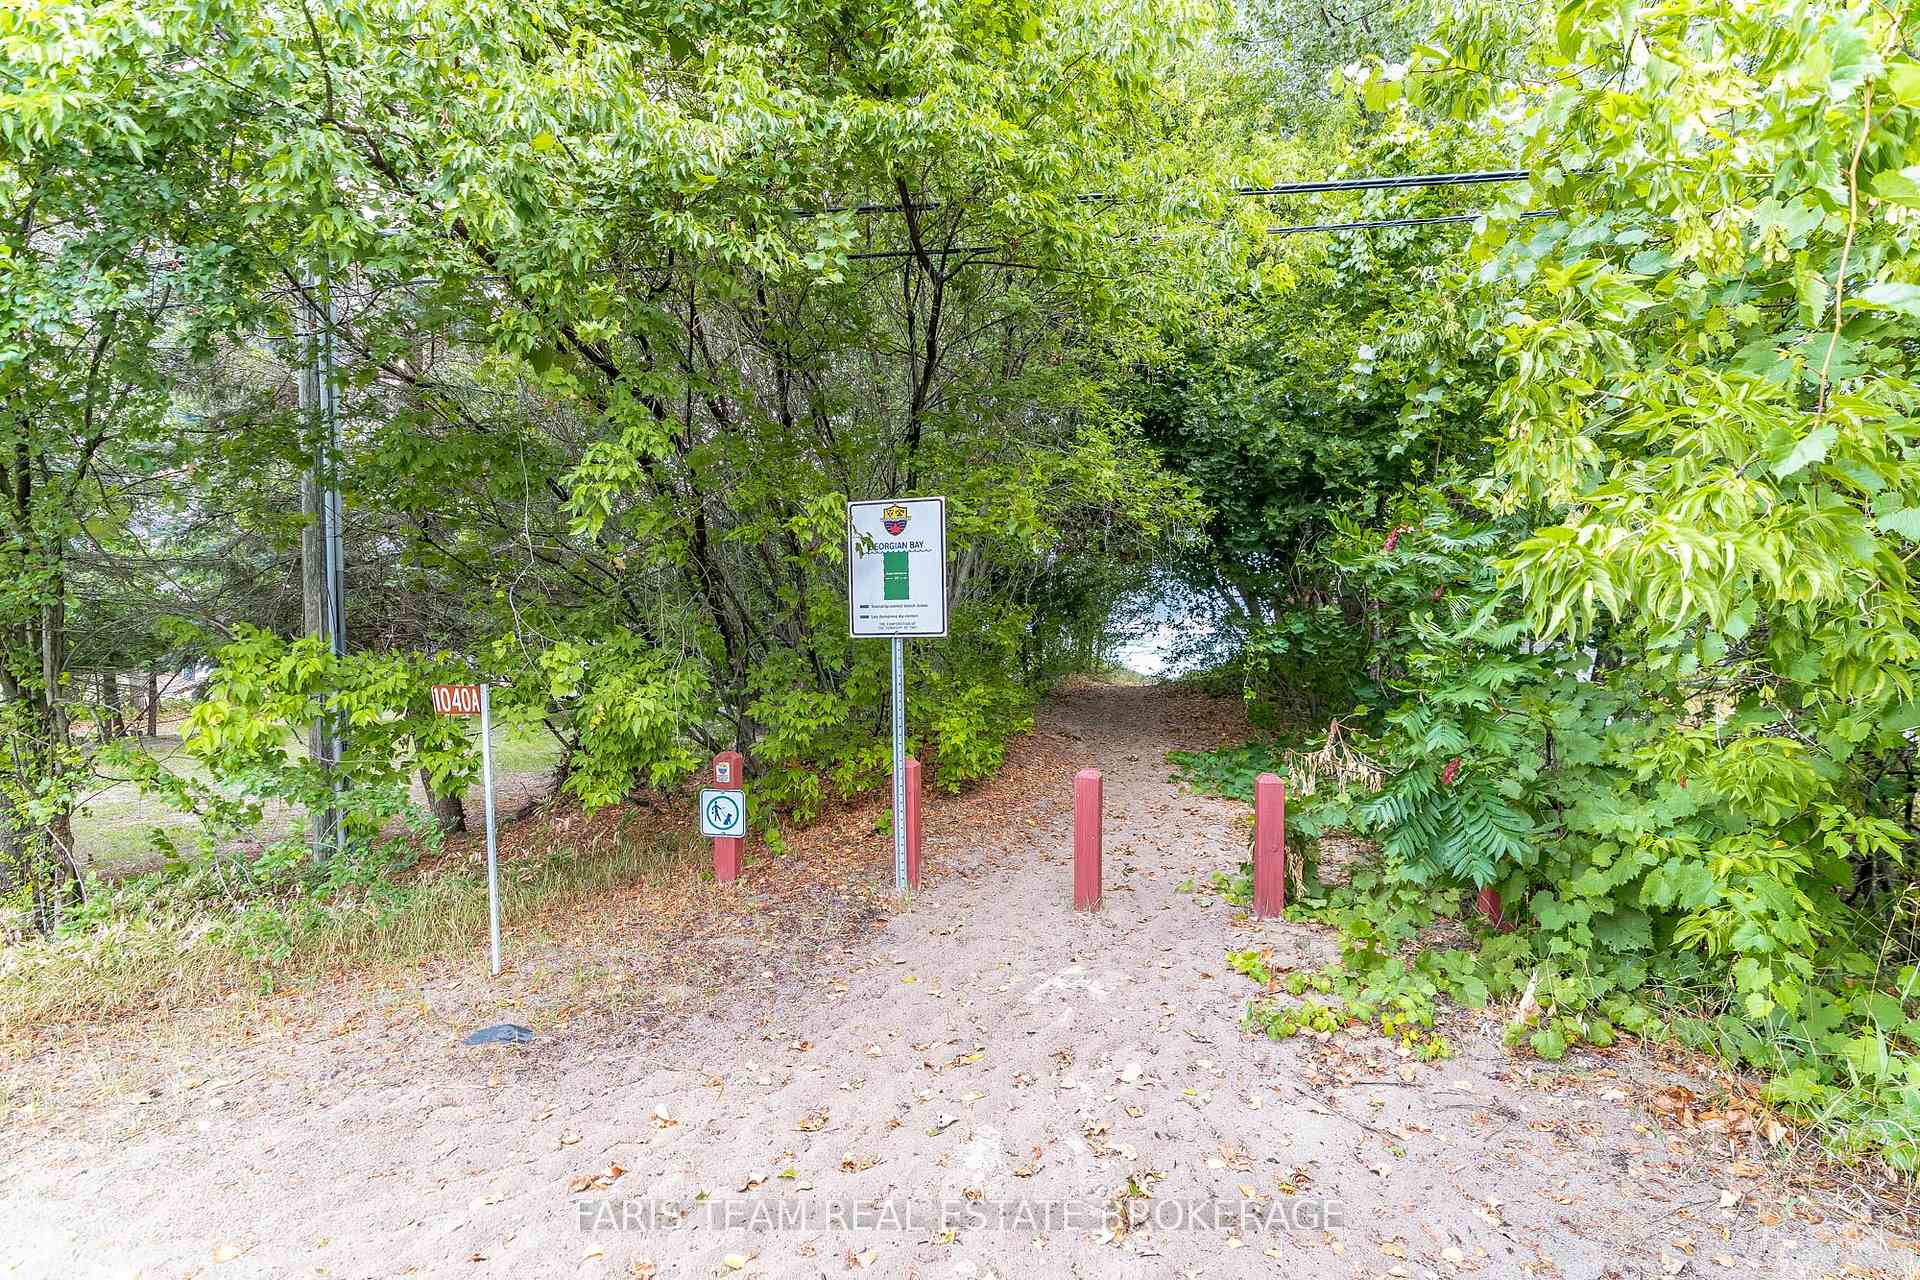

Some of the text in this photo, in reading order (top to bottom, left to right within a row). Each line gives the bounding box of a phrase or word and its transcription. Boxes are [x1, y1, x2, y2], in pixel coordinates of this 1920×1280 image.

[869, 540, 924, 551] EORGIAN BAY
[434, 687, 480, 712] 1040A
